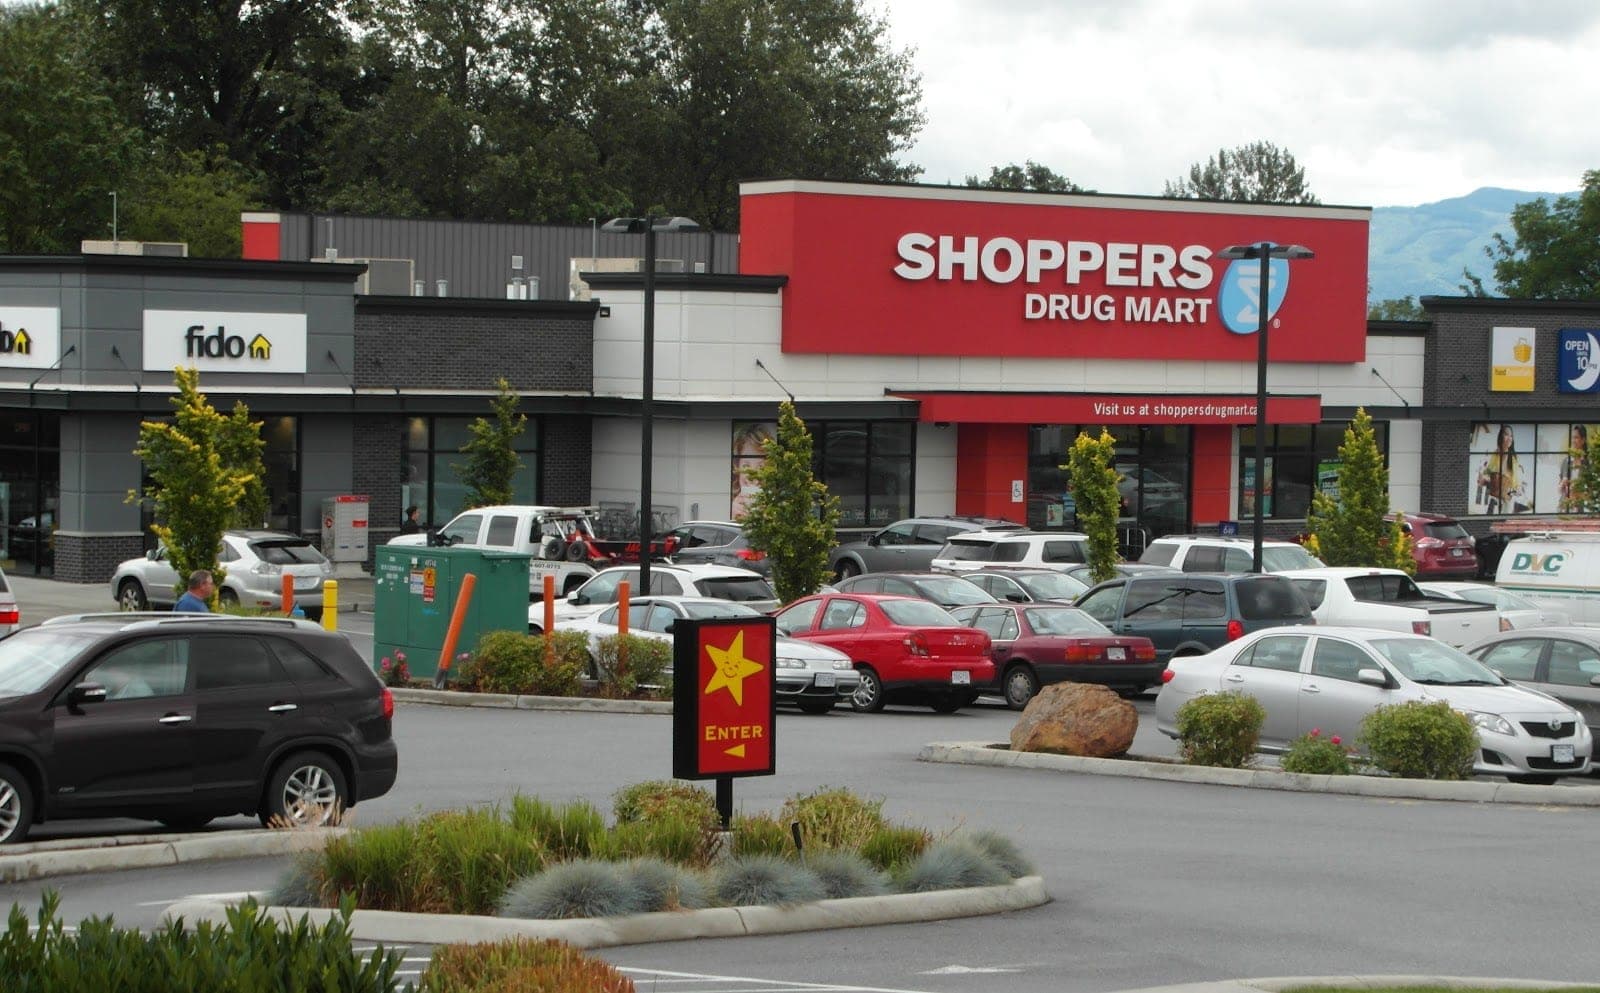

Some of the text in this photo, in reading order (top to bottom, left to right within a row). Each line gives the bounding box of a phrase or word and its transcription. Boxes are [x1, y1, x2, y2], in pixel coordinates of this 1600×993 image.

[894, 233, 1214, 290] SHOPPERS
[1025, 293, 1213, 324] DRUG MART
[185, 325, 245, 359] fido
[1565, 340, 1589, 351] OPEN
[1576, 356, 1588, 370] 10
[1094, 402, 1258, 418] Visit us at shoppersdrugmart.ca
[1511, 553, 1564, 572] DVC
[705, 725, 764, 741] ENTER
